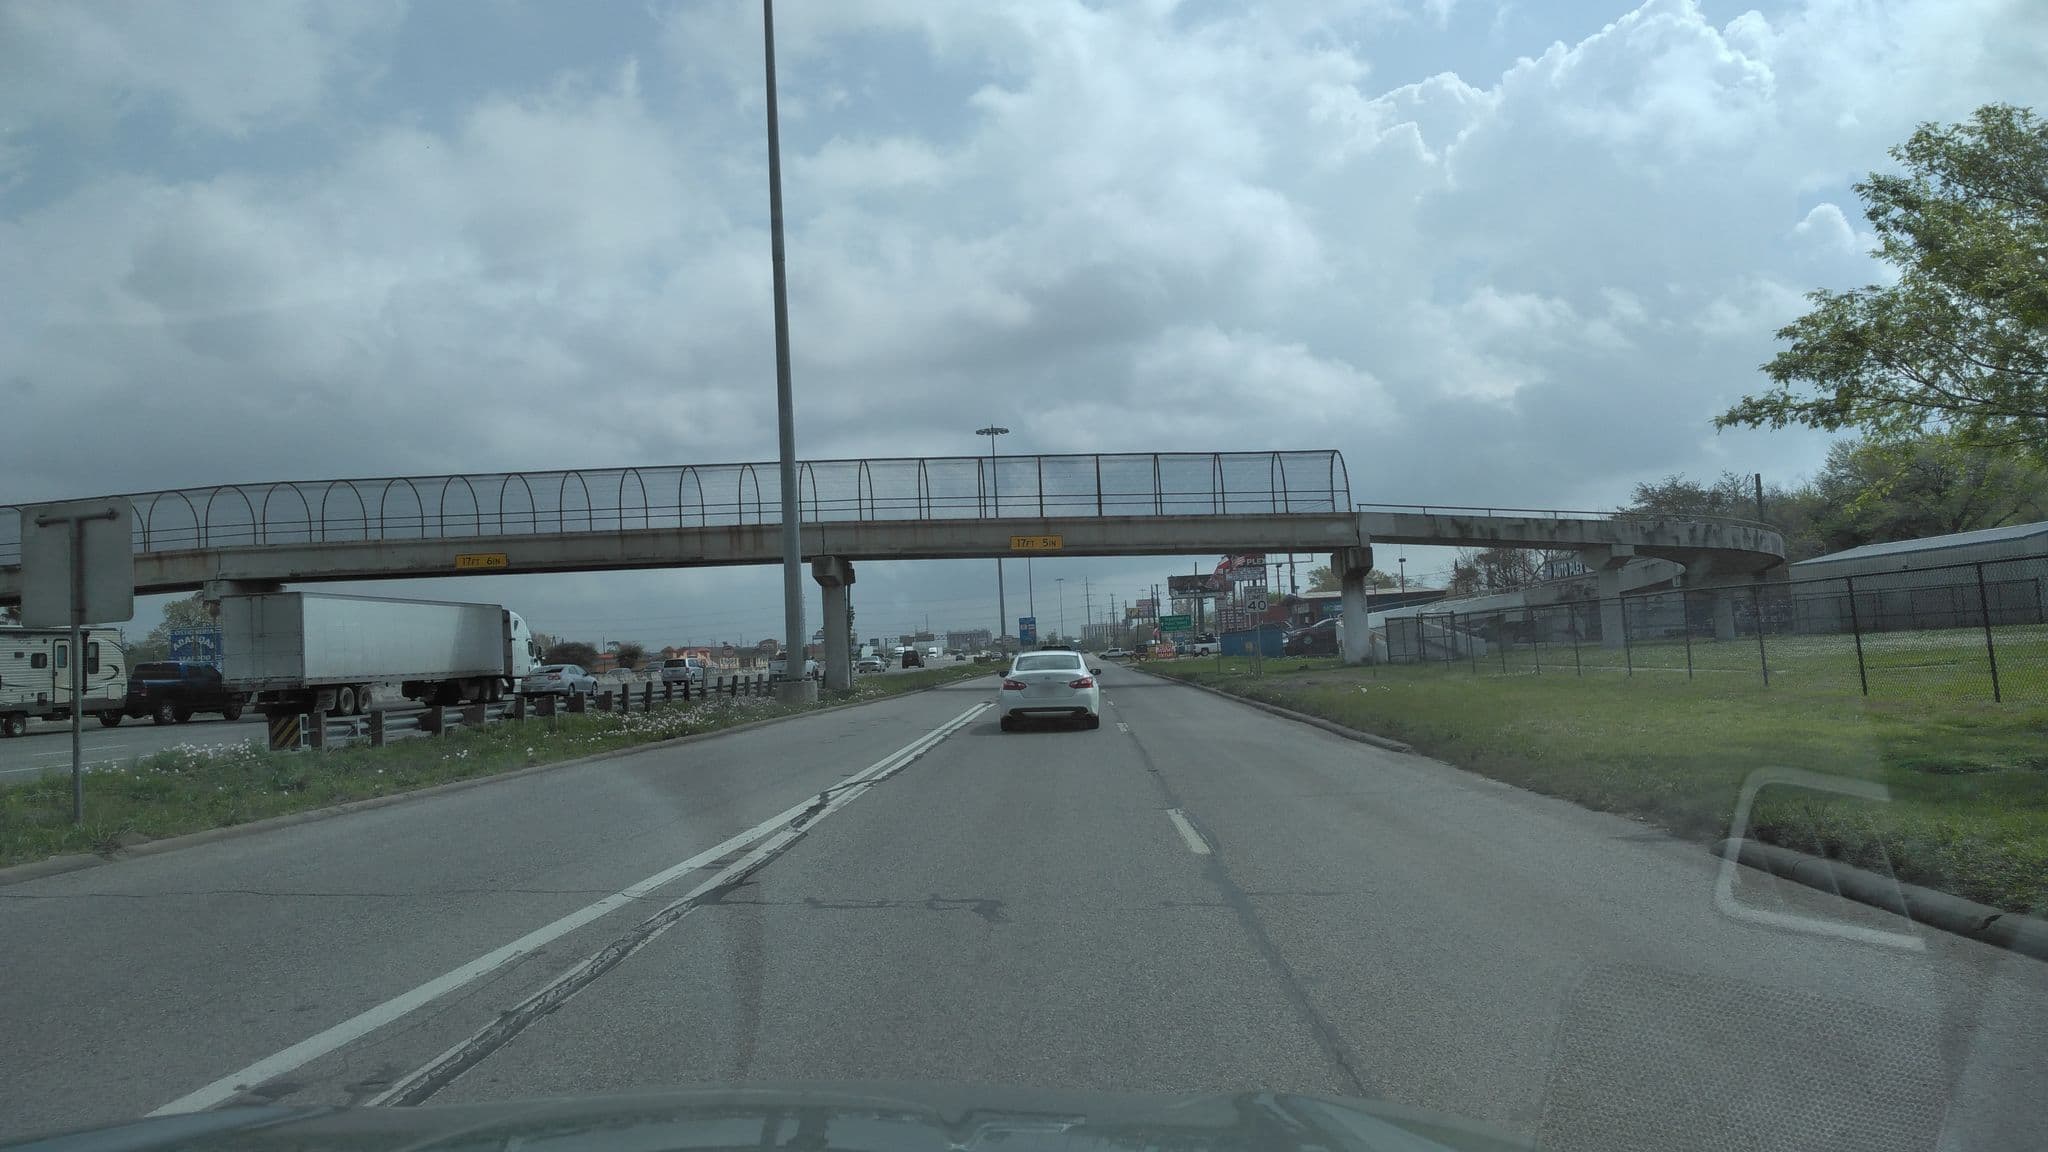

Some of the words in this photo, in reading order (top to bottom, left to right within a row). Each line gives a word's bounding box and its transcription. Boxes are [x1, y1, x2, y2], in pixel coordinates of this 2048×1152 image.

[1017, 538, 1035, 548] 17FT
[1042, 537, 1057, 548] 5IN
[1247, 600, 1267, 610] 40
